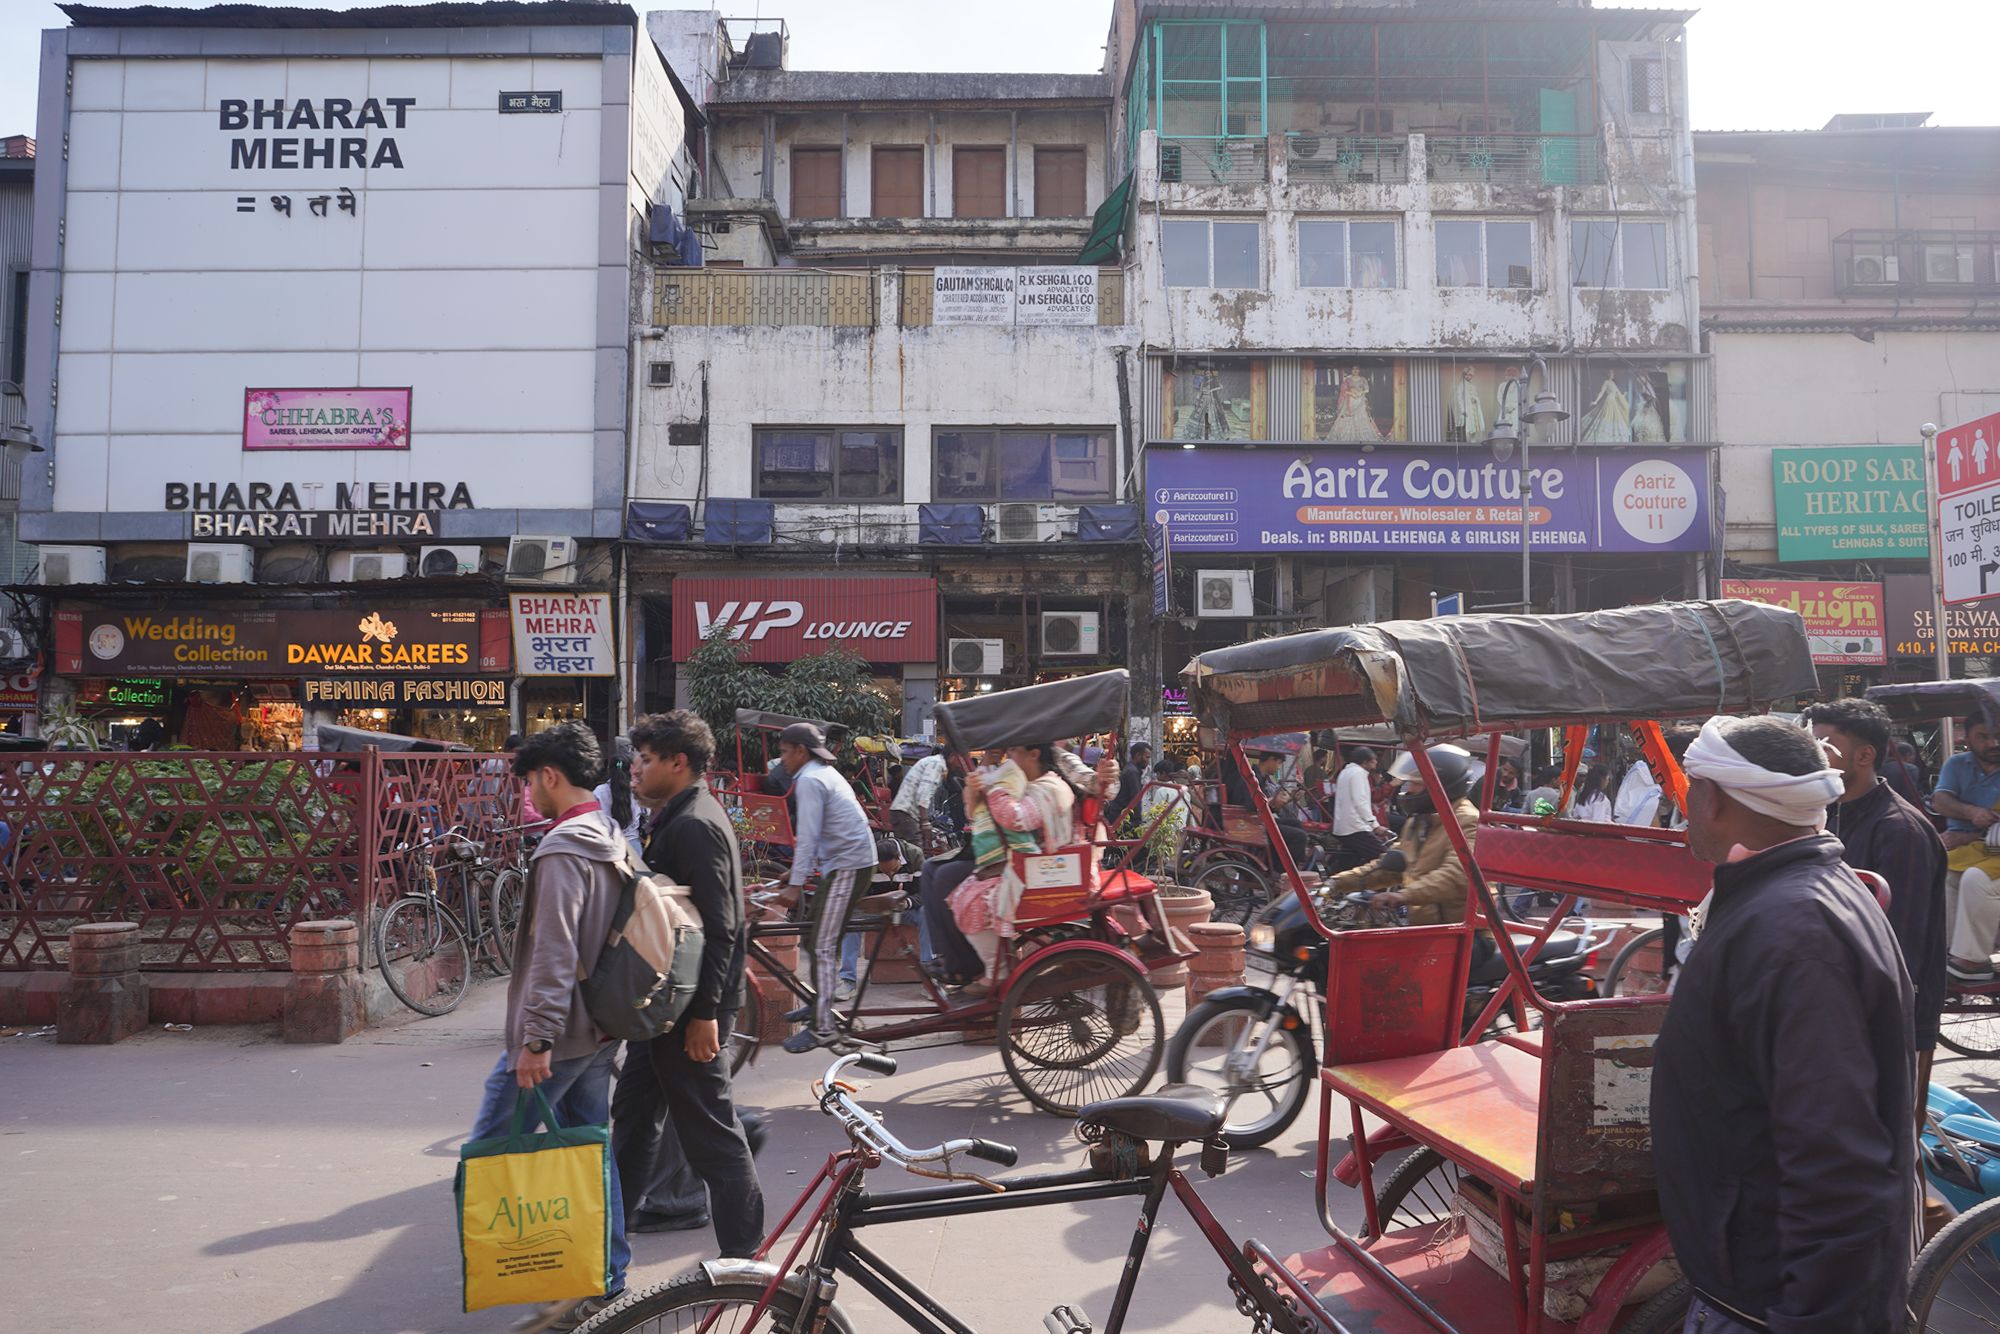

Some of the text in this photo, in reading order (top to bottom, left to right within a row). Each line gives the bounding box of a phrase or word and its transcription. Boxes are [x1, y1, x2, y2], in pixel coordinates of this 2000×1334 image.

[219, 97, 416, 130] BHARAT
[230, 137, 404, 169] MEHRA
[936, 277, 974, 292] GAUTAM
[974, 277, 1004, 292] SEHGAL
[1036, 274, 1072, 286] SEHGAL
[1047, 286, 1090, 294] ADVOCATES
[969, 293, 1006, 305] ACCOUNTANTS
[1037, 293, 1075, 305] SEHGAL
[1047, 305, 1092, 313] ADVOCATES
[261, 407, 394, 427] CHHABRA'S
[269, 428, 298, 436] SAREES,
[300, 428, 333, 436] LEHENGA,
[1283, 458, 1564, 500] Aariz Couture
[1781, 459, 1857, 484] ROOP
[1634, 474, 1676, 490] Aariz
[164, 481, 475, 511] BHARAT MEHRA
[1173, 491, 1235, 501] Aarizcouture11
[1623, 494, 1687, 510] Couture
[1475, 508, 1485, 521] &
[1491, 508, 1540, 521] Retaier
[1954, 494, 2000, 521] TOILE
[193, 512, 434, 537] BHARAT MEHRA
[1173, 511, 1235, 522] Aarizcouture11
[1647, 514, 1664, 530] 11
[1173, 532, 1235, 542] Aarizcouture11
[1261, 530, 1587, 545] Deals. in: BRIDAL LEHENGA & GIRLISH EHENGA
[1781, 526, 1801, 537] ALL
[1804, 526, 1839, 536] TYPES
[1842, 525, 1856, 535] OF
[1859, 525, 1888, 535] SILK,
[1945, 528, 1964, 543] जन
[1832, 537, 1884, 549] LEHNGAS
[1887, 537, 1895, 547] &
[1947, 552, 1967, 568] 100
[1726, 583, 1777, 596] Kapoor
[518, 597, 602, 616] BHARAT
[525, 617, 597, 635] MEHRA
[694, 600, 912, 641] VIP LOUNGE
[1857, 618, 1878, 627] Mall
[123, 616, 236, 646] Wedding
[1826, 628, 1844, 636] AND
[1845, 628, 1879, 636] POTTLIS
[1916, 627, 1970, 639] GROM
[174, 643, 268, 662] Collection
[531, 636, 592, 653] भरत
[1896, 641, 1926, 655] 410,
[287, 643, 469, 664] DAWAR SAREES
[480, 656, 496, 666] 06
[108, 686, 164, 703] Collection
[305, 680, 506, 702] FEMINA FASHION
[488, 1196, 571, 1239] Ajwa
